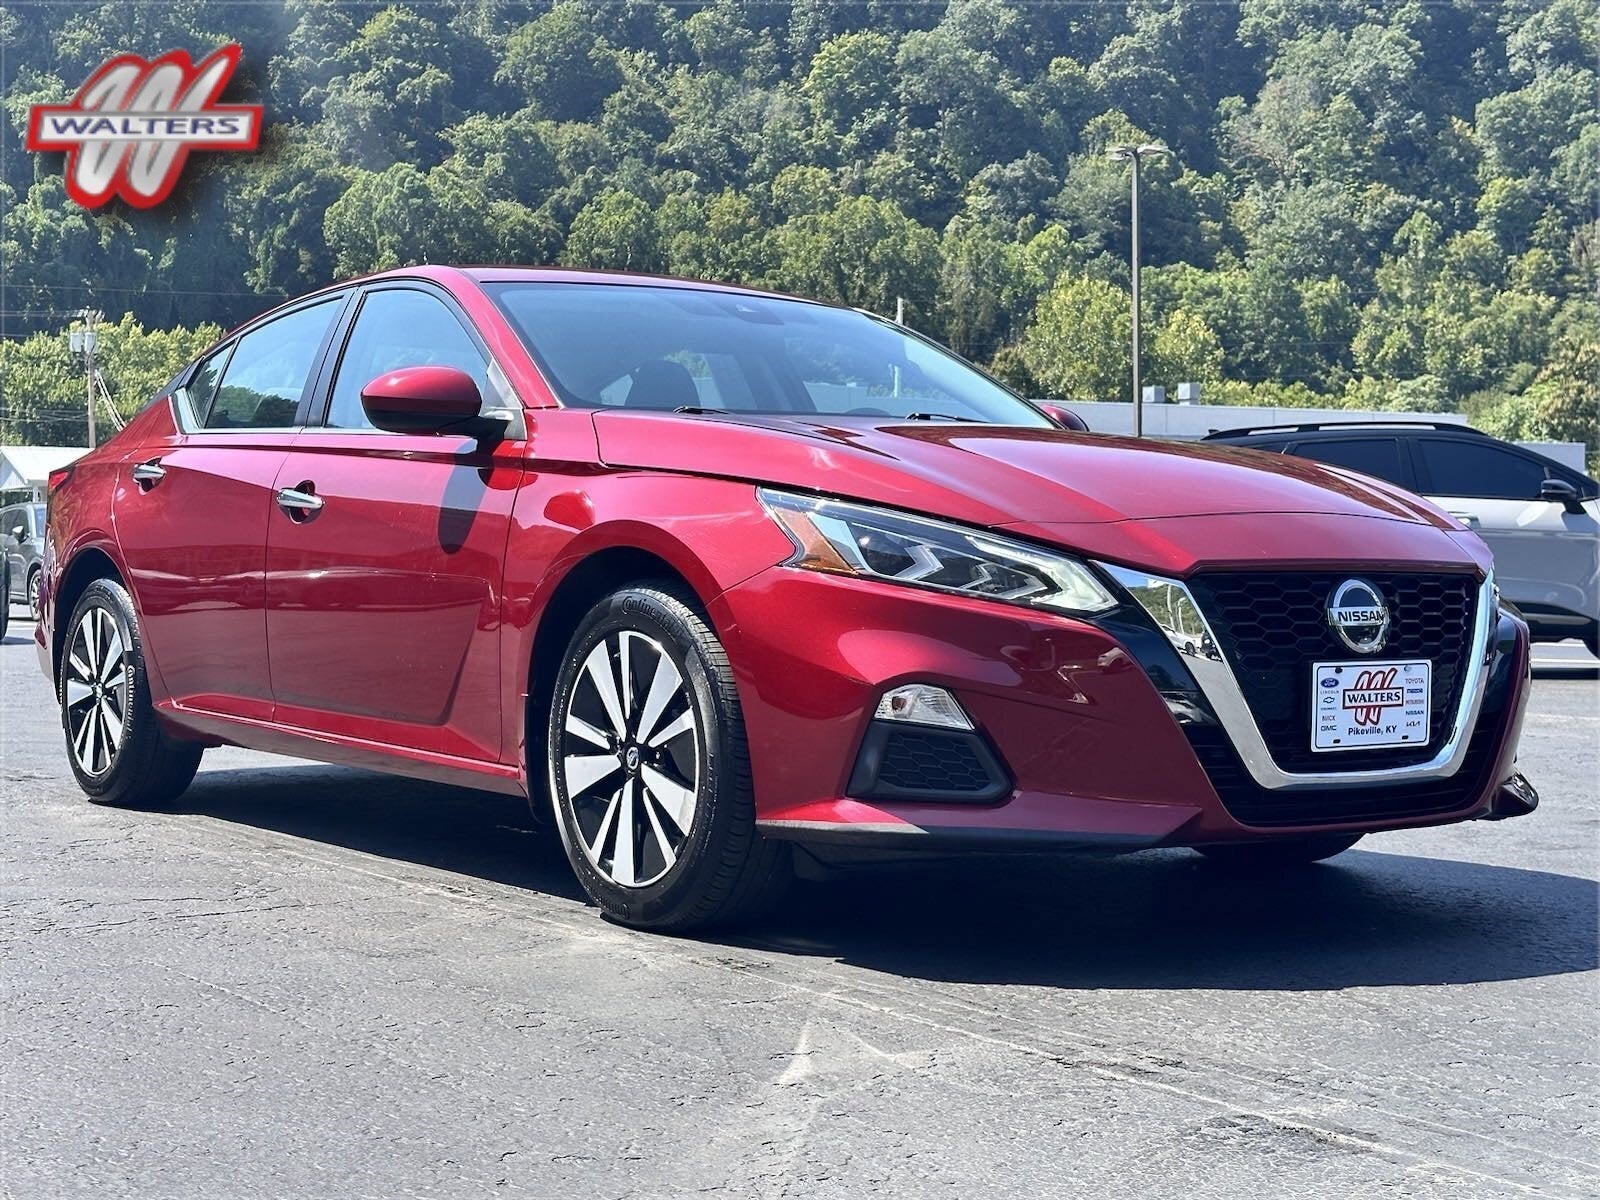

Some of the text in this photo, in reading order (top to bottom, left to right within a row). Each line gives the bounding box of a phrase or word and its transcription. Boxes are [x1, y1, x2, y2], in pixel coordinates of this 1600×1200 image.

[1337, 610, 1384, 622] NISSAN
[1347, 692, 1400, 703] WALTERS
[1348, 725, 1397, 735] Pikeville, KY
